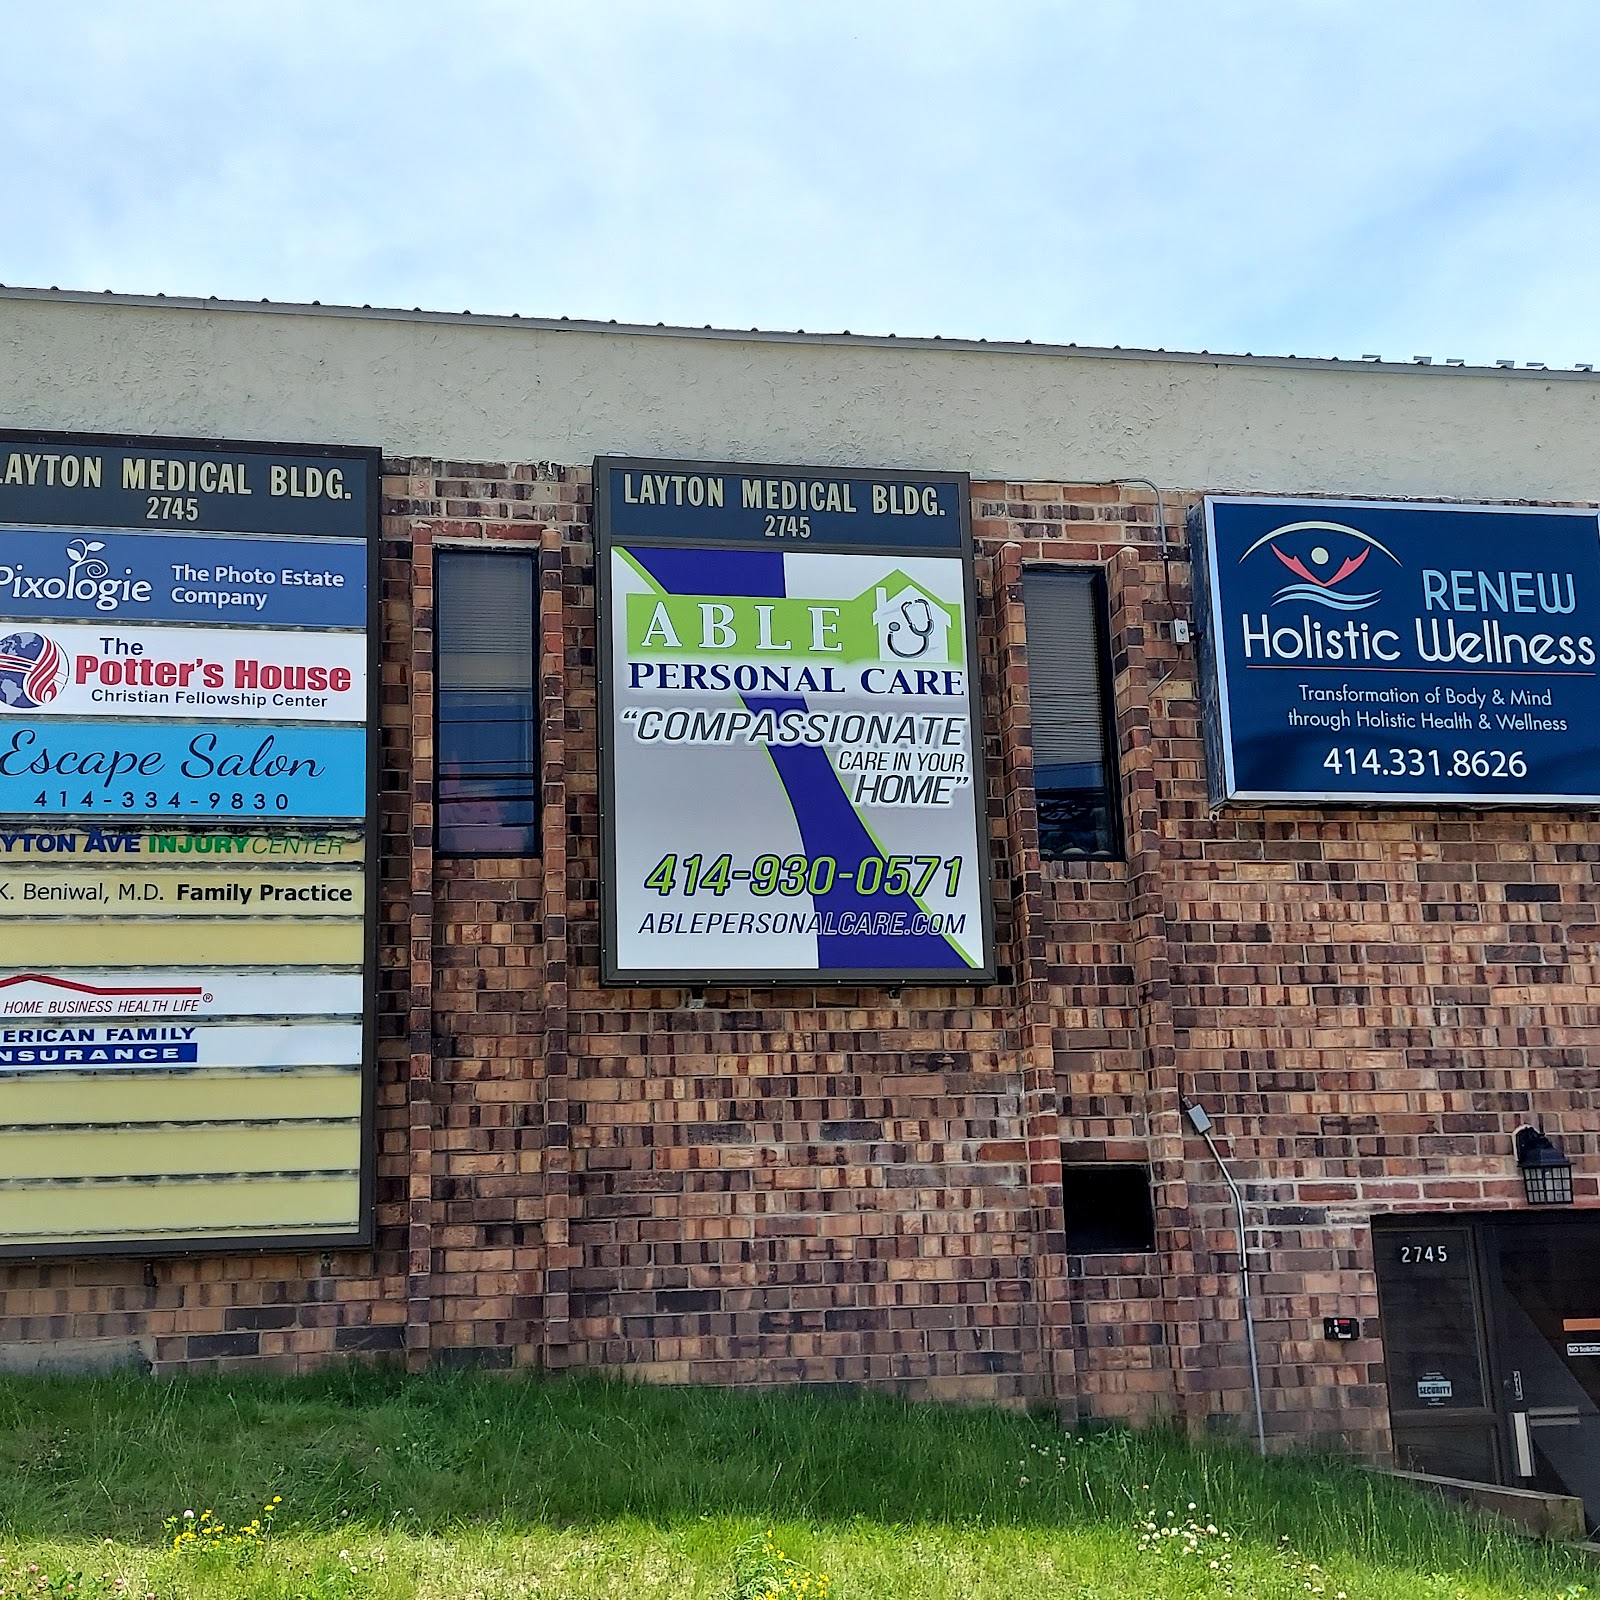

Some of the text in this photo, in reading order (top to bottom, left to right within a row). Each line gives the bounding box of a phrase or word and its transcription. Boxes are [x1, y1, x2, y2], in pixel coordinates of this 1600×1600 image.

[0, 453, 352, 500] AYTON MEDICAL BLDG.
[624, 473, 946, 516] LAYTON MEDICAL BLDG.
[146, 496, 199, 522] 2745
[764, 515, 812, 538] 2745
[171, 564, 345, 588] The Photo Estate
[171, 587, 268, 611] Company
[1422, 569, 1577, 614] RENEW
[641, 601, 844, 652] ABLE
[99, 637, 144, 656] The
[1242, 613, 1596, 666] Holistic Wellness
[234, 660, 352, 692] House
[627, 661, 965, 697] PERSONAL CARE
[91, 689, 328, 708] Christian Fellowship Center
[1298, 684, 1552, 709] Transformation of Body & Mind
[1287, 708, 1568, 731] through Holistic Health & Wellness
[1, 729, 325, 788] Escape Salon
[838, 751, 965, 772] CARE IN YOUR
[1323, 747, 1527, 777] 414.331.8626
[33, 790, 289, 810] 414-334-9830
[83, 827, 141, 852] AVE
[149, 835, 250, 853] INJURY
[252, 836, 344, 854] CENTER
[644, 854, 963, 897] 414-930-0571
[23, 882, 109, 904] Beniwal,
[119, 883, 164, 901] M.D.
[177, 884, 253, 905] Family
[260, 884, 353, 901] Practice
[637, 912, 966, 935] ABLEPERSONALCARE.COM
[3, 999, 200, 1014] HOME BUSINESS HEALTH LIFE
[106, 1027, 196, 1041] FAMILY
[1401, 1246, 1447, 1263] 2745
